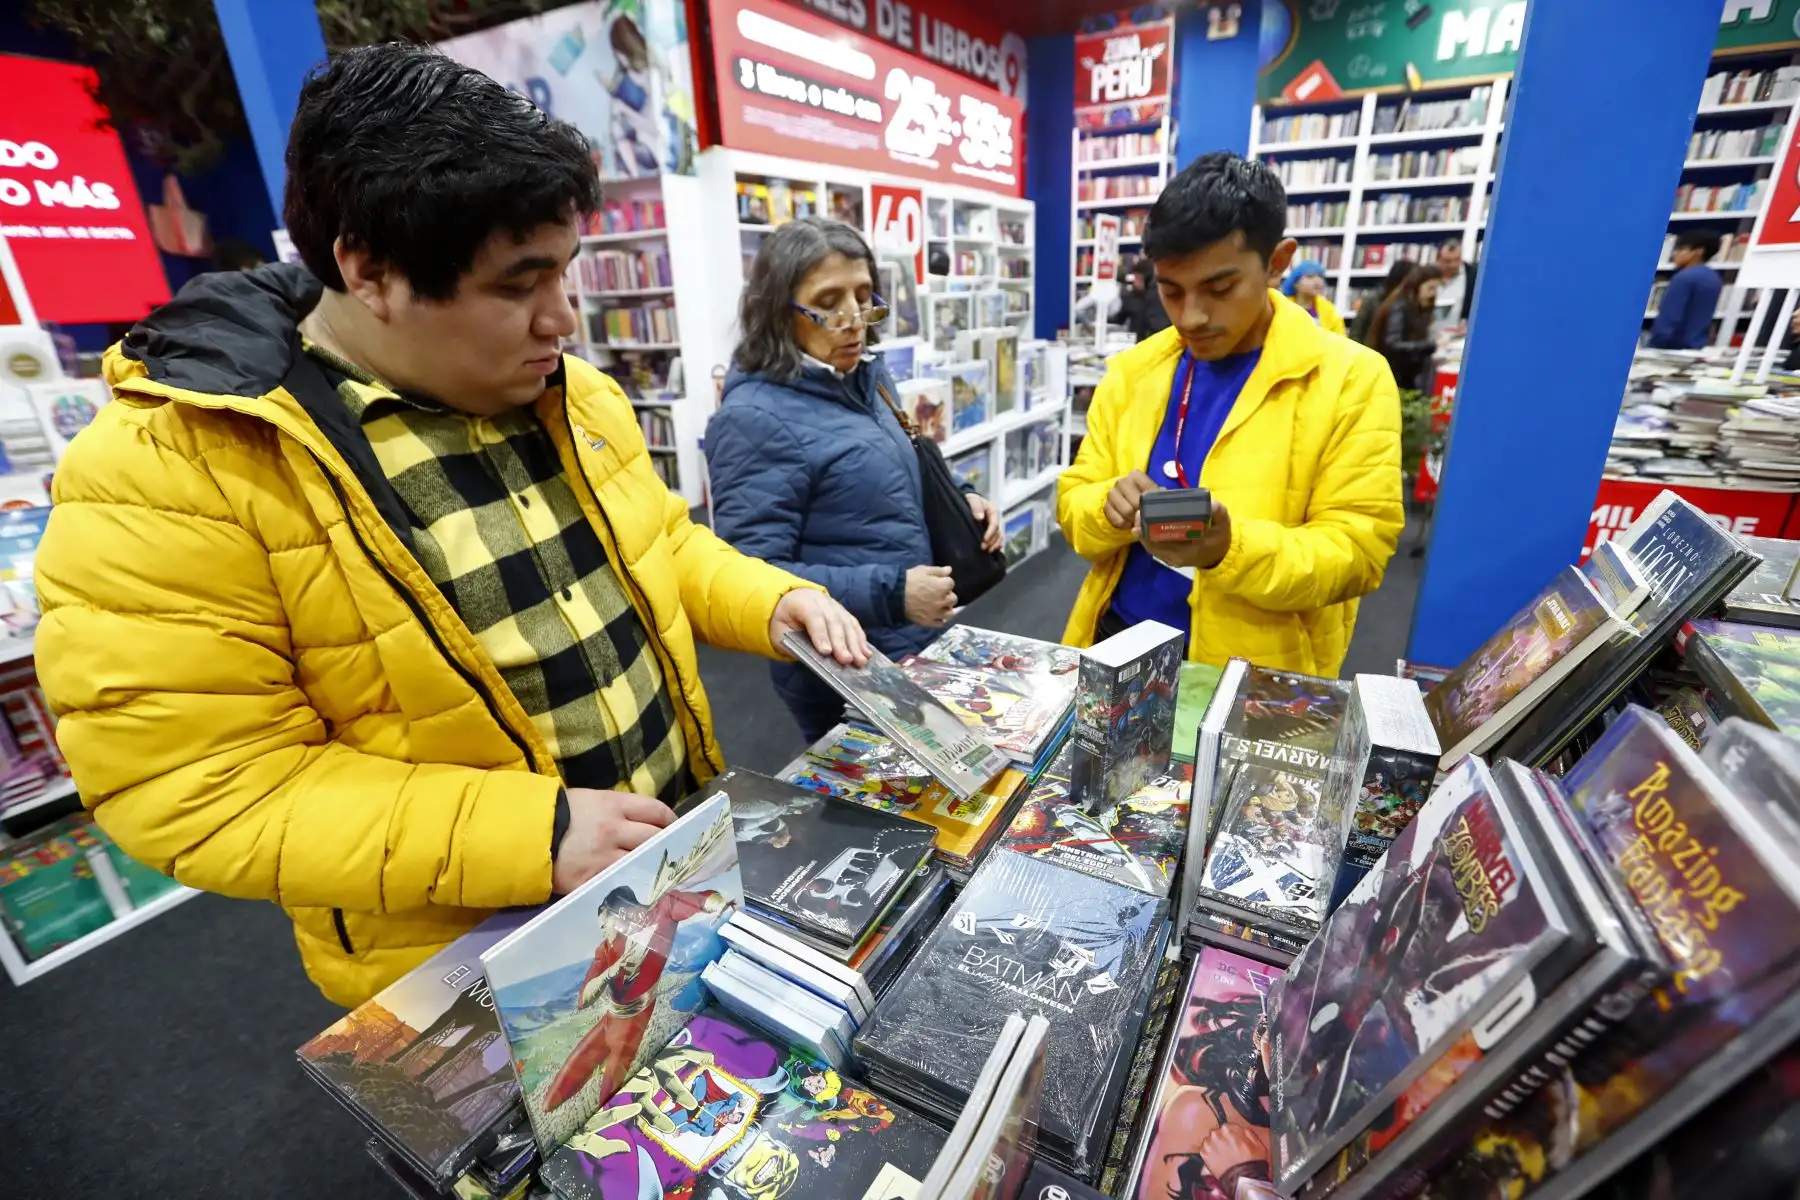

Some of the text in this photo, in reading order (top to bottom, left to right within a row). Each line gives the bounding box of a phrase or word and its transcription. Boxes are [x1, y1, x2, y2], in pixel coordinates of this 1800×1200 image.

[875, 0, 914, 48] DE
[920, 12, 1000, 81] LIBROS
[739, 57, 755, 89] 3
[808, 84, 822, 107] o
[33, 175, 120, 209] MÁS
[1625, 535, 1693, 608] LOGAN
[1663, 527, 1701, 566] LOBEZNO:
[1629, 761, 1746, 931] Amazing
[443, 964, 471, 988] EL
[461, 978, 495, 1011] MO
[963, 946, 1084, 1005] BATMAN
[999, 981, 1074, 1014] HALLOWEEN
[1484, 1065, 1549, 1120] HARLEY
